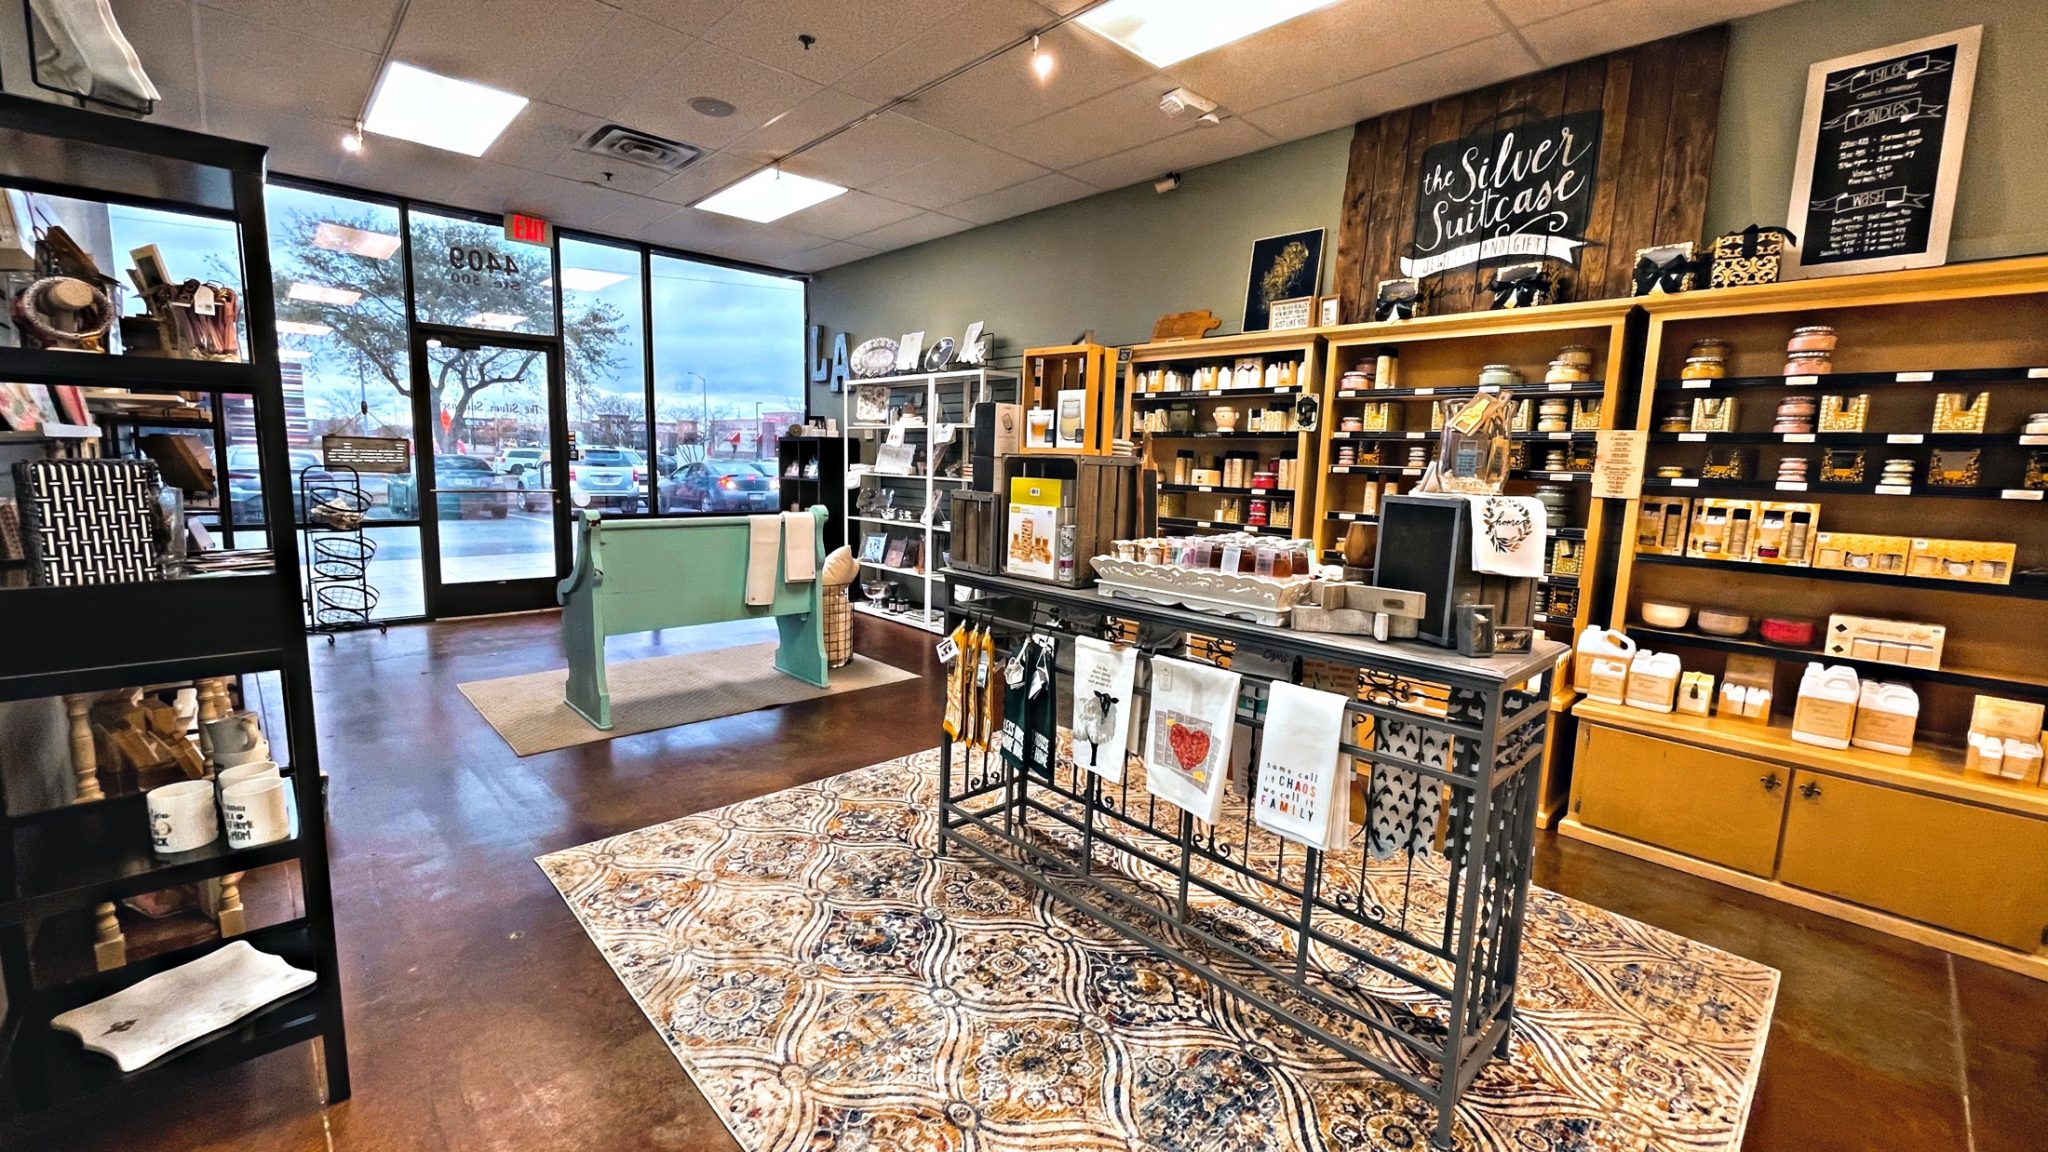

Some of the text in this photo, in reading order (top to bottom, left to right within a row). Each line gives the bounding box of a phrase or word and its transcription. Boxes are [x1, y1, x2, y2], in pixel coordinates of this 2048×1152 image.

[1870, 60, 1909, 84] TYLER
[1855, 100, 1911, 127] CANDLES
[1423, 126, 1592, 202] the Silver
[1415, 169, 1586, 252] Suitcase
[512, 213, 546, 243] EXIT
[1482, 238, 1505, 256] AND
[1490, 510, 1524, 527] home
[1267, 762, 1318, 783] some call
[1263, 786, 1275, 795] we
[1280, 791, 1299, 803] call
[1265, 775, 1316, 797] it CHAOS
[1261, 794, 1314, 822] FAMILY
